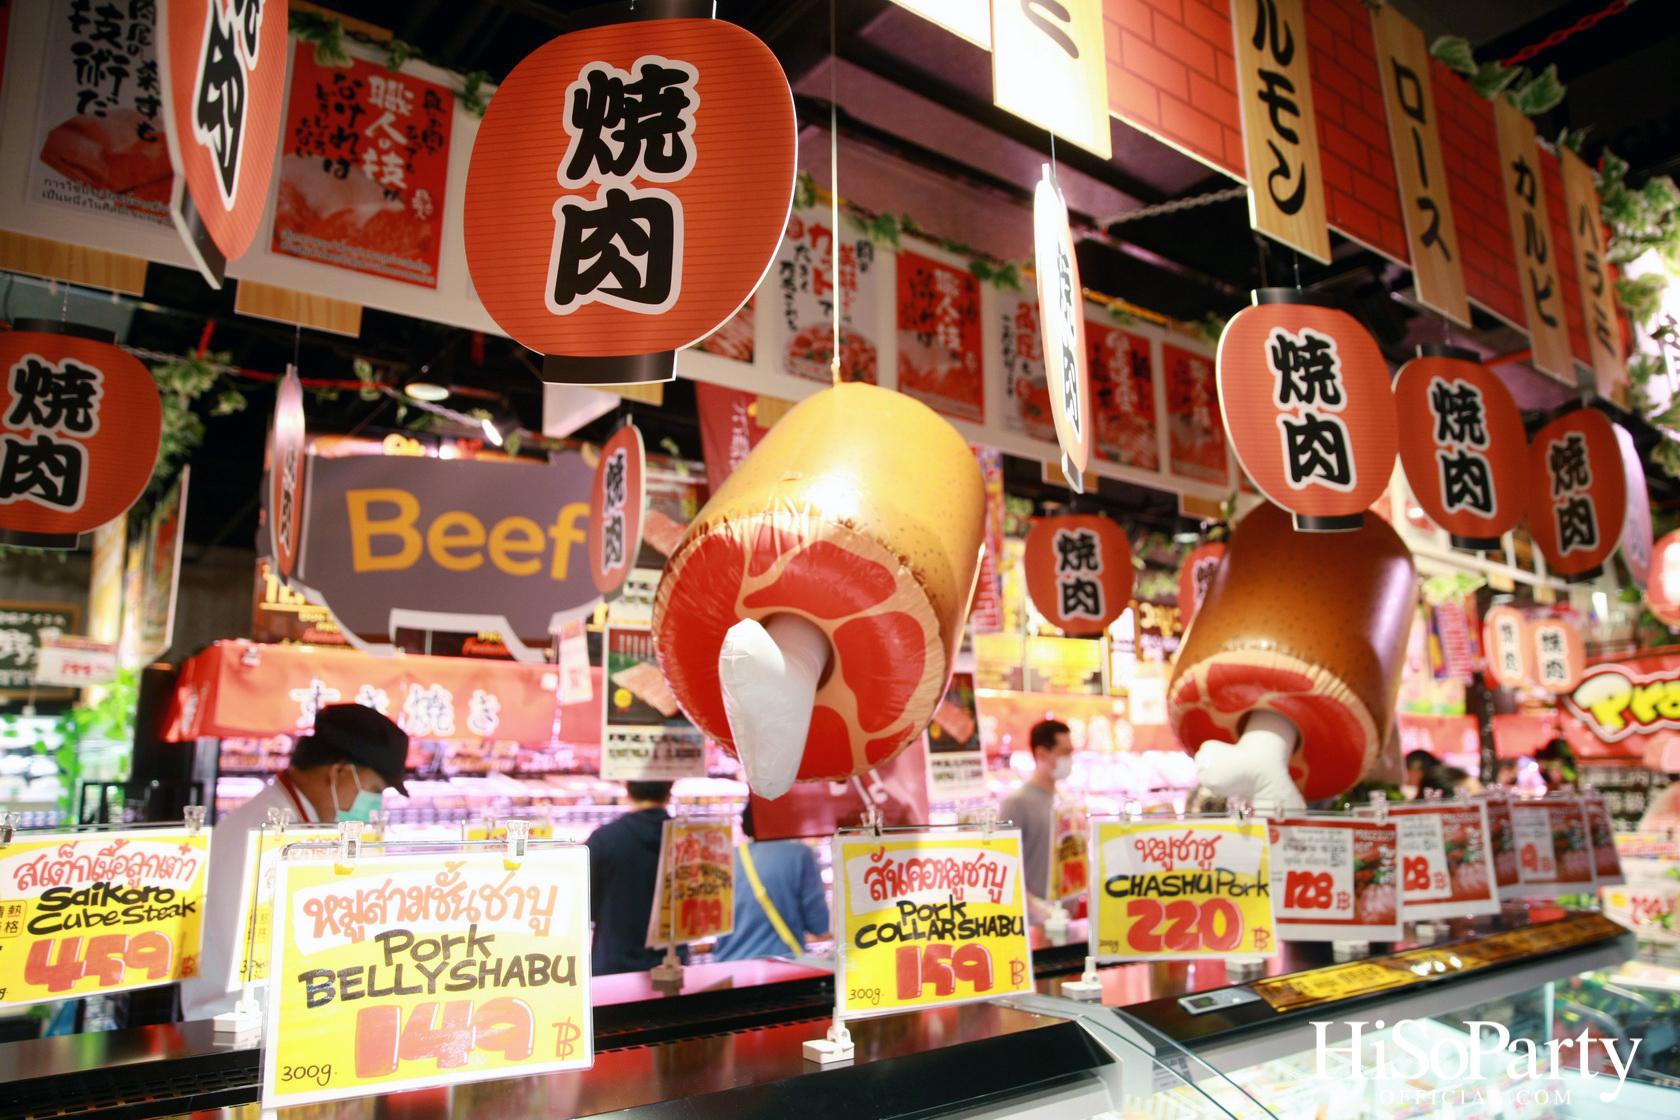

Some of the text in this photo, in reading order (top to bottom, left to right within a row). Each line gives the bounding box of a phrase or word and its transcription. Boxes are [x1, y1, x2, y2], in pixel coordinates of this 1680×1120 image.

[361, 75, 416, 190] 職人の技
[1391, 56, 1452, 262] ロース
[554, 63, 692, 307] 焼肉
[1511, 155, 1559, 328] カルビ
[0, 359, 98, 508] 焼肉
[1271, 334, 1351, 486] 焼肉
[1433, 381, 1493, 514] 焼肉
[346, 488, 588, 580] Beef
[605, 452, 625, 570] 焼肉
[1551, 435, 1597, 553] 焼肉
[1057, 533, 1101, 616] 焼肉
[303, 861, 559, 943] หมูสามชั้นชาบู
[896, 894, 967, 926] Pork
[1126, 897, 1244, 952] 220
[1283, 870, 1334, 909] 128
[24, 930, 173, 993] 459
[374, 924, 495, 967] Pork
[896, 943, 994, 1000] 159
[354, 997, 535, 1078] 149
